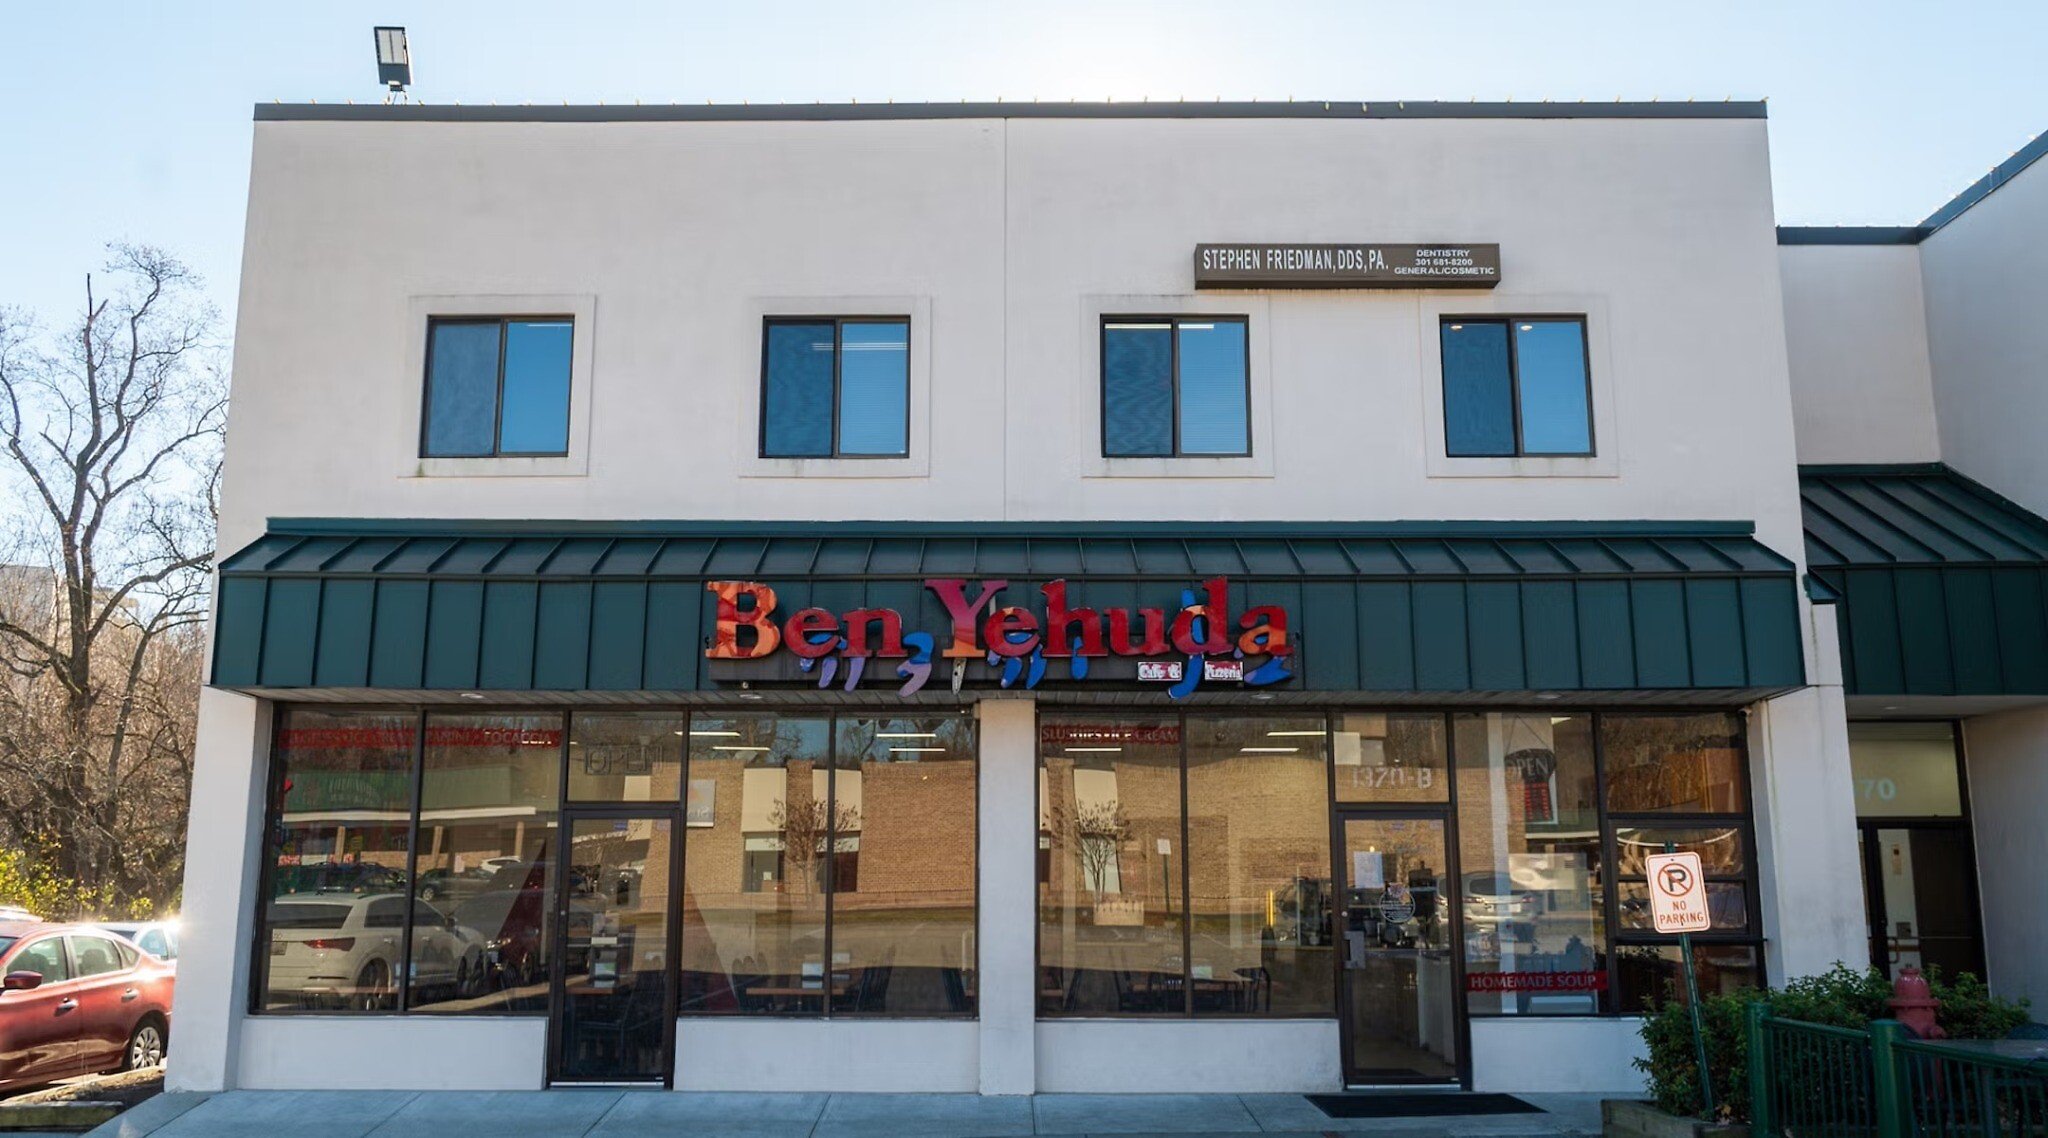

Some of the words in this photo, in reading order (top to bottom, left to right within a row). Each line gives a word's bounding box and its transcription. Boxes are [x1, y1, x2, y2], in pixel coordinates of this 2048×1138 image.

[1203, 249, 1261, 270] STEPHEN
[1416, 249, 1470, 257] DENTISTRY
[1415, 258, 1431, 266] 301
[1433, 258, 1473, 266] 681-8200
[1394, 266, 1495, 275] GENERAL/COSMETIC
[705, 580, 908, 659] Ben
[925, 575, 1293, 657] Yehuda
[483, 731, 552, 745] FOCACCIA
[1135, 729, 1179, 742] CREAM
[1854, 777, 1897, 801] 70
[1672, 900, 1687, 911] NO
[1660, 912, 1704, 925] PARKING
[1471, 975, 1553, 988] HOMEMADE
[1556, 974, 1597, 987] SOUP
